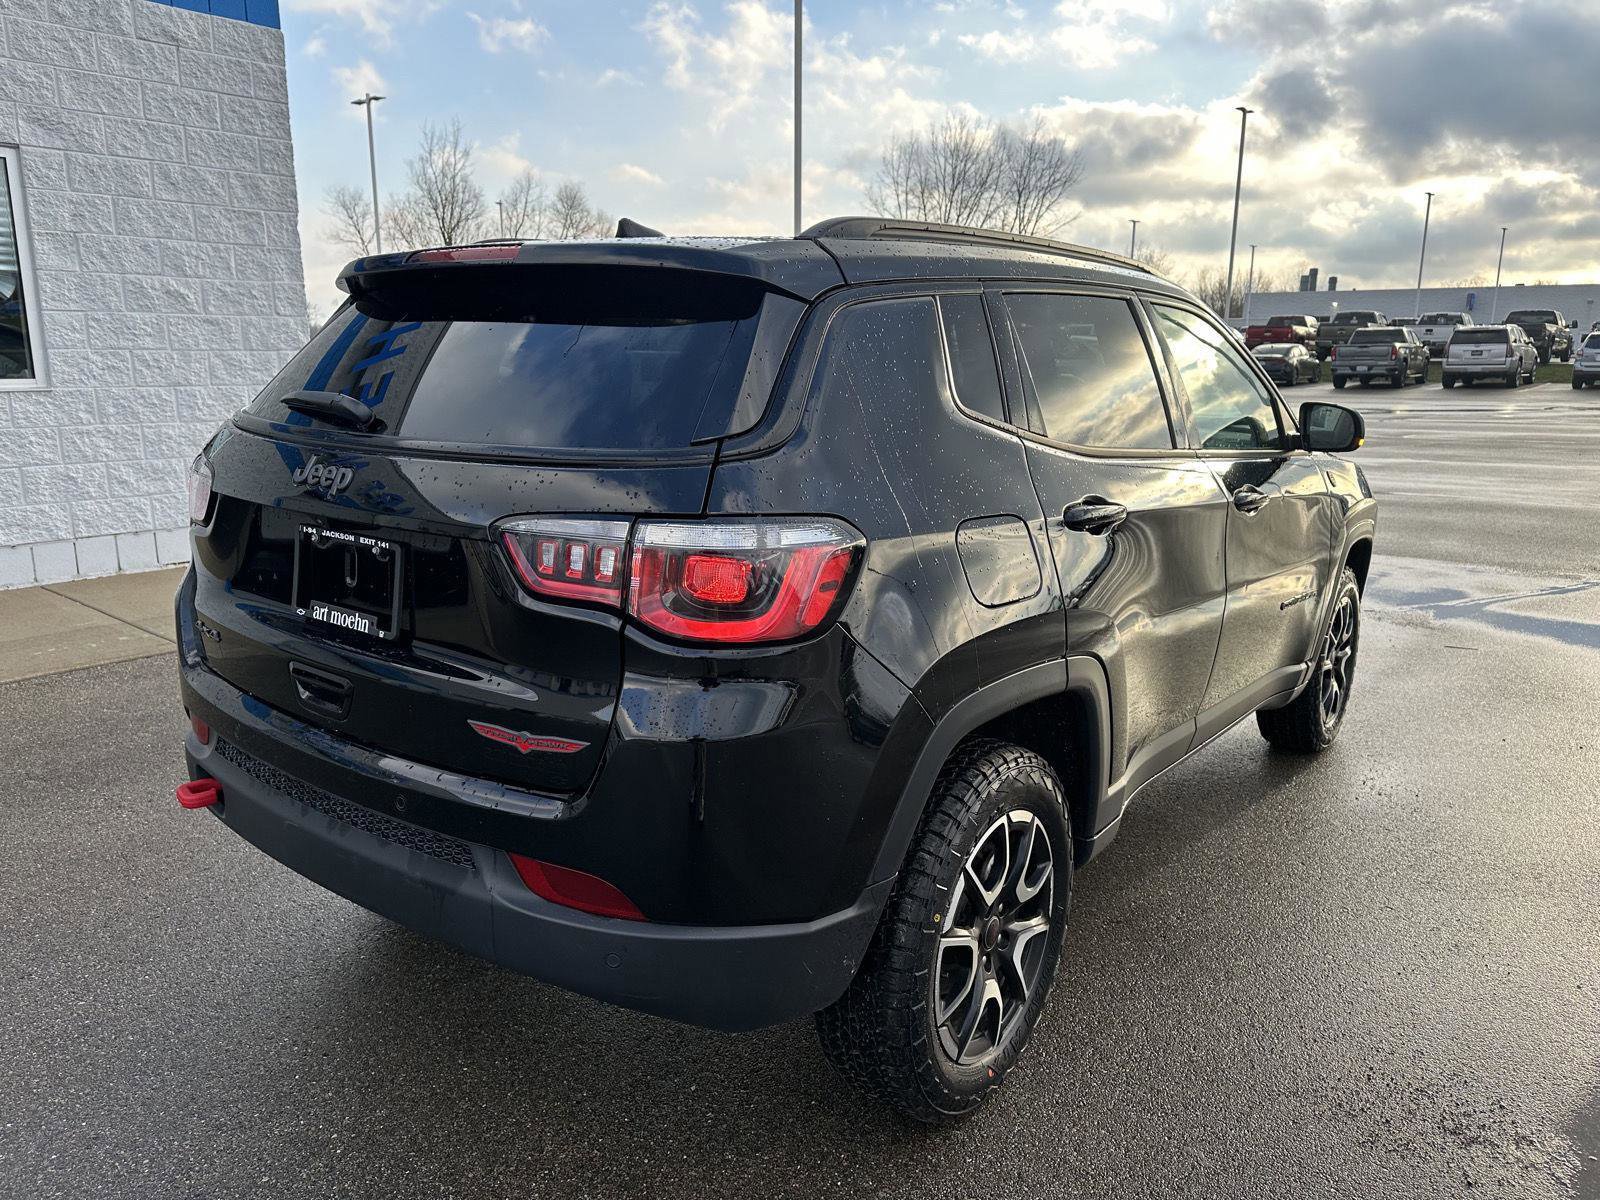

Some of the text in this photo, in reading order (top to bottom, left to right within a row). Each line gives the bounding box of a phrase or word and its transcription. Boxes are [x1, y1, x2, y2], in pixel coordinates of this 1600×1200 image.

[292, 453, 354, 500] Jeep
[303, 526, 390, 549] I-94 JACKSON EXIT 141
[312, 605, 369, 634] art moehn
